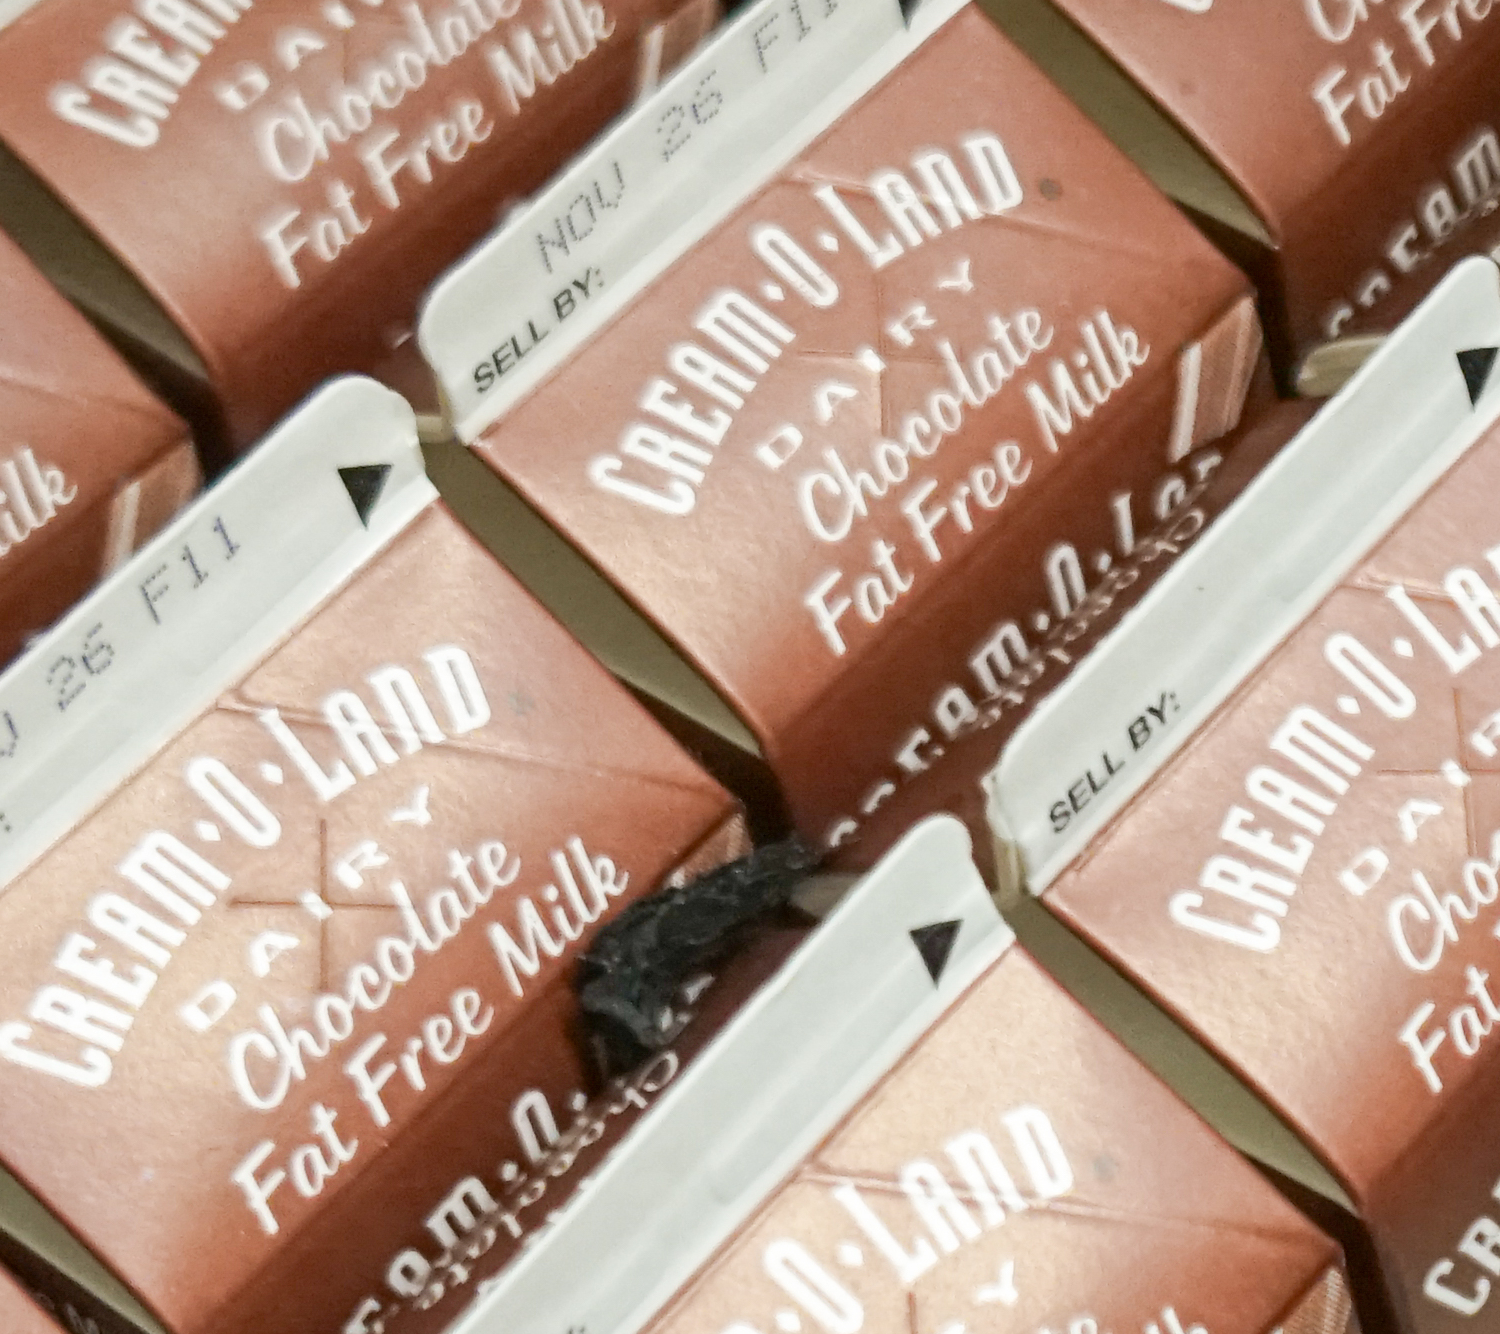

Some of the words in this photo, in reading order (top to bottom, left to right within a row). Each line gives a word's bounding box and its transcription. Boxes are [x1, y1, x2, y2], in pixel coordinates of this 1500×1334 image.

[656, 73, 725, 161] 26
[1313, 42, 1410, 147] Fat
[262, 183, 374, 289] Fat
[362, 94, 494, 211] Free
[473, 321, 552, 395] SELL
[553, 265, 606, 321] BY:
[799, 307, 1055, 545] Chocolate
[805, 540, 914, 655] Fat
[903, 437, 1032, 563] Free
[1028, 309, 1151, 451] Milk
[46, 622, 114, 711] 26
[1048, 751, 1123, 836] SELL
[1125, 690, 1182, 751] BY:
[226, 838, 521, 1115] Chocolate
[233, 1108, 359, 1235] Fat
[347, 989, 494, 1126] Free
[496, 831, 629, 994] Milk
